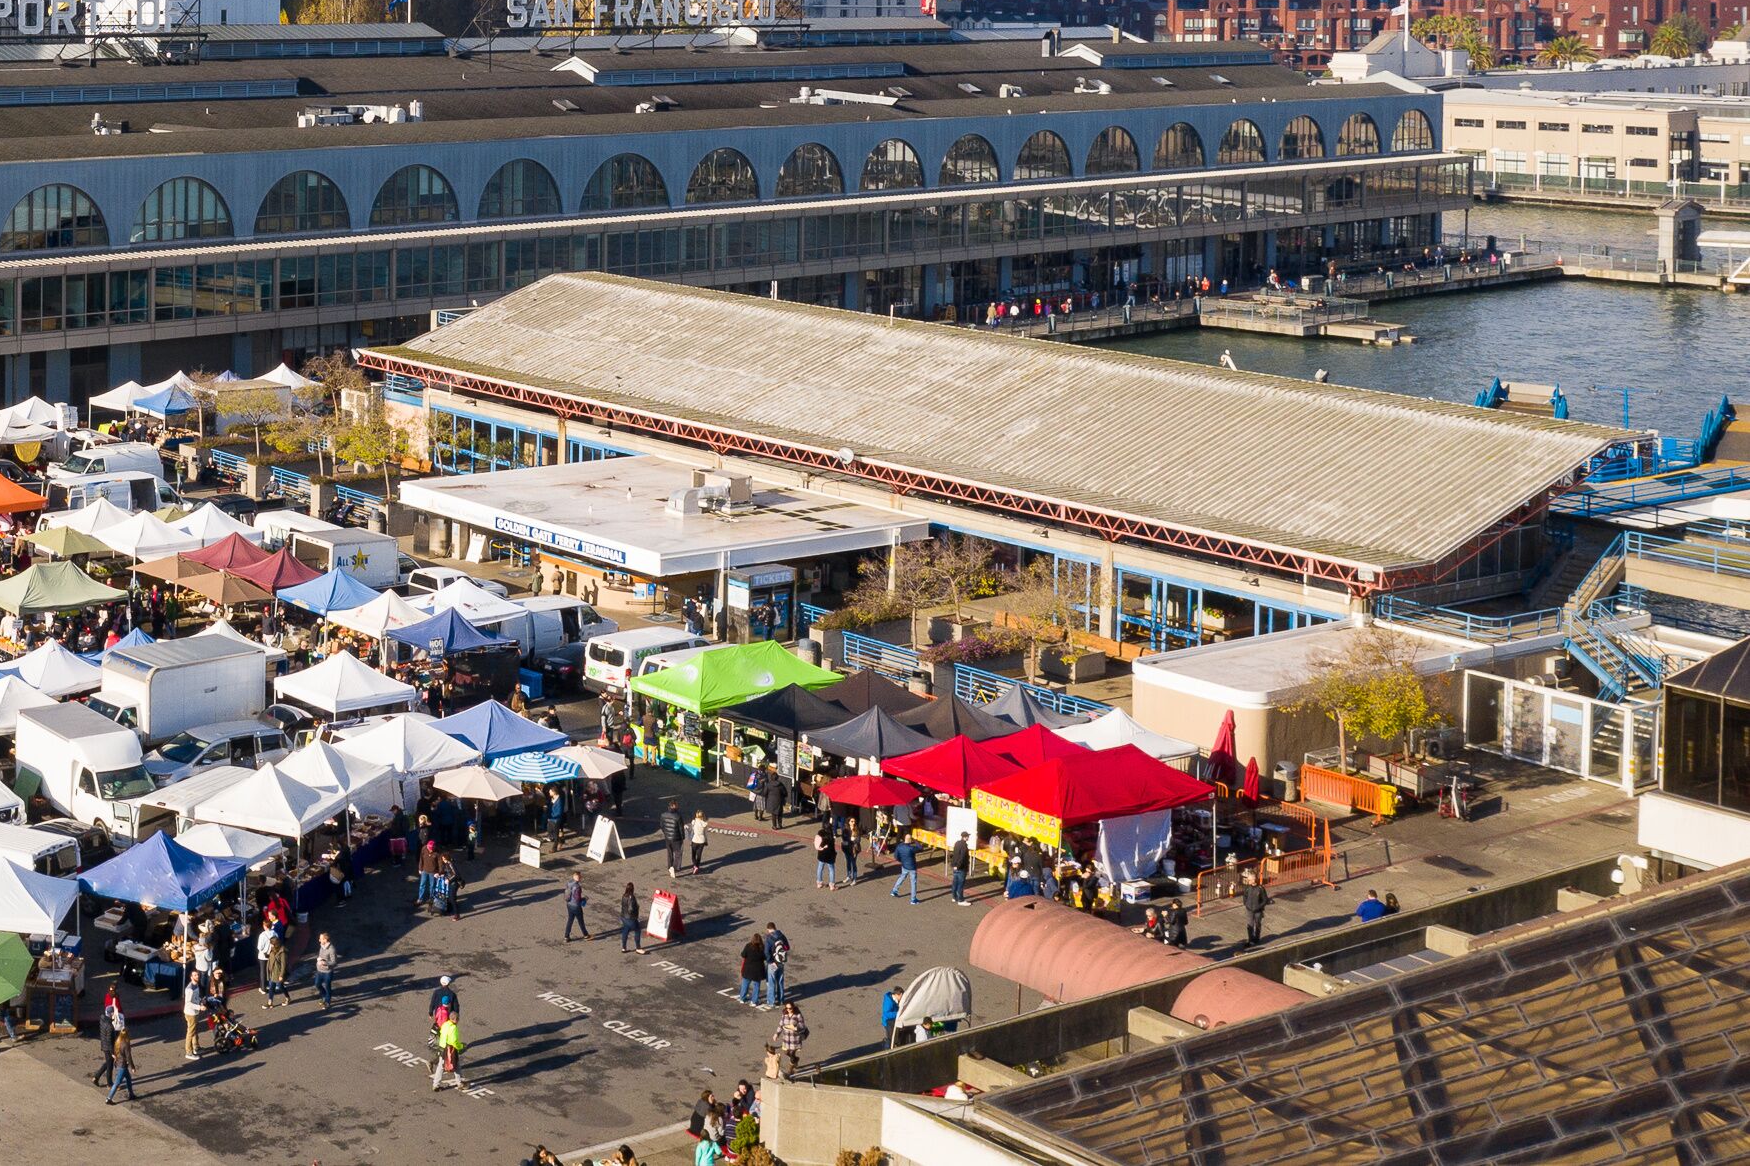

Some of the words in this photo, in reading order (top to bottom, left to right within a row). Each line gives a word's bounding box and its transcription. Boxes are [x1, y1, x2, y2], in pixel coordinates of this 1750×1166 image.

[496, 518, 530, 537] GOLDEN
[531, 527, 552, 543] GATE
[554, 534, 579, 551] FERRY
[581, 541, 625, 563] TERMINAL
[753, 572, 791, 586] TICKETS
[977, 791, 1057, 828] PRIMAVERA
[1028, 824, 1056, 839] FOOD
[651, 960, 704, 982] FIRE
[536, 991, 592, 1015] KEEP
[603, 1020, 671, 1050] CLEAR
[373, 1042, 425, 1068] FIRE
